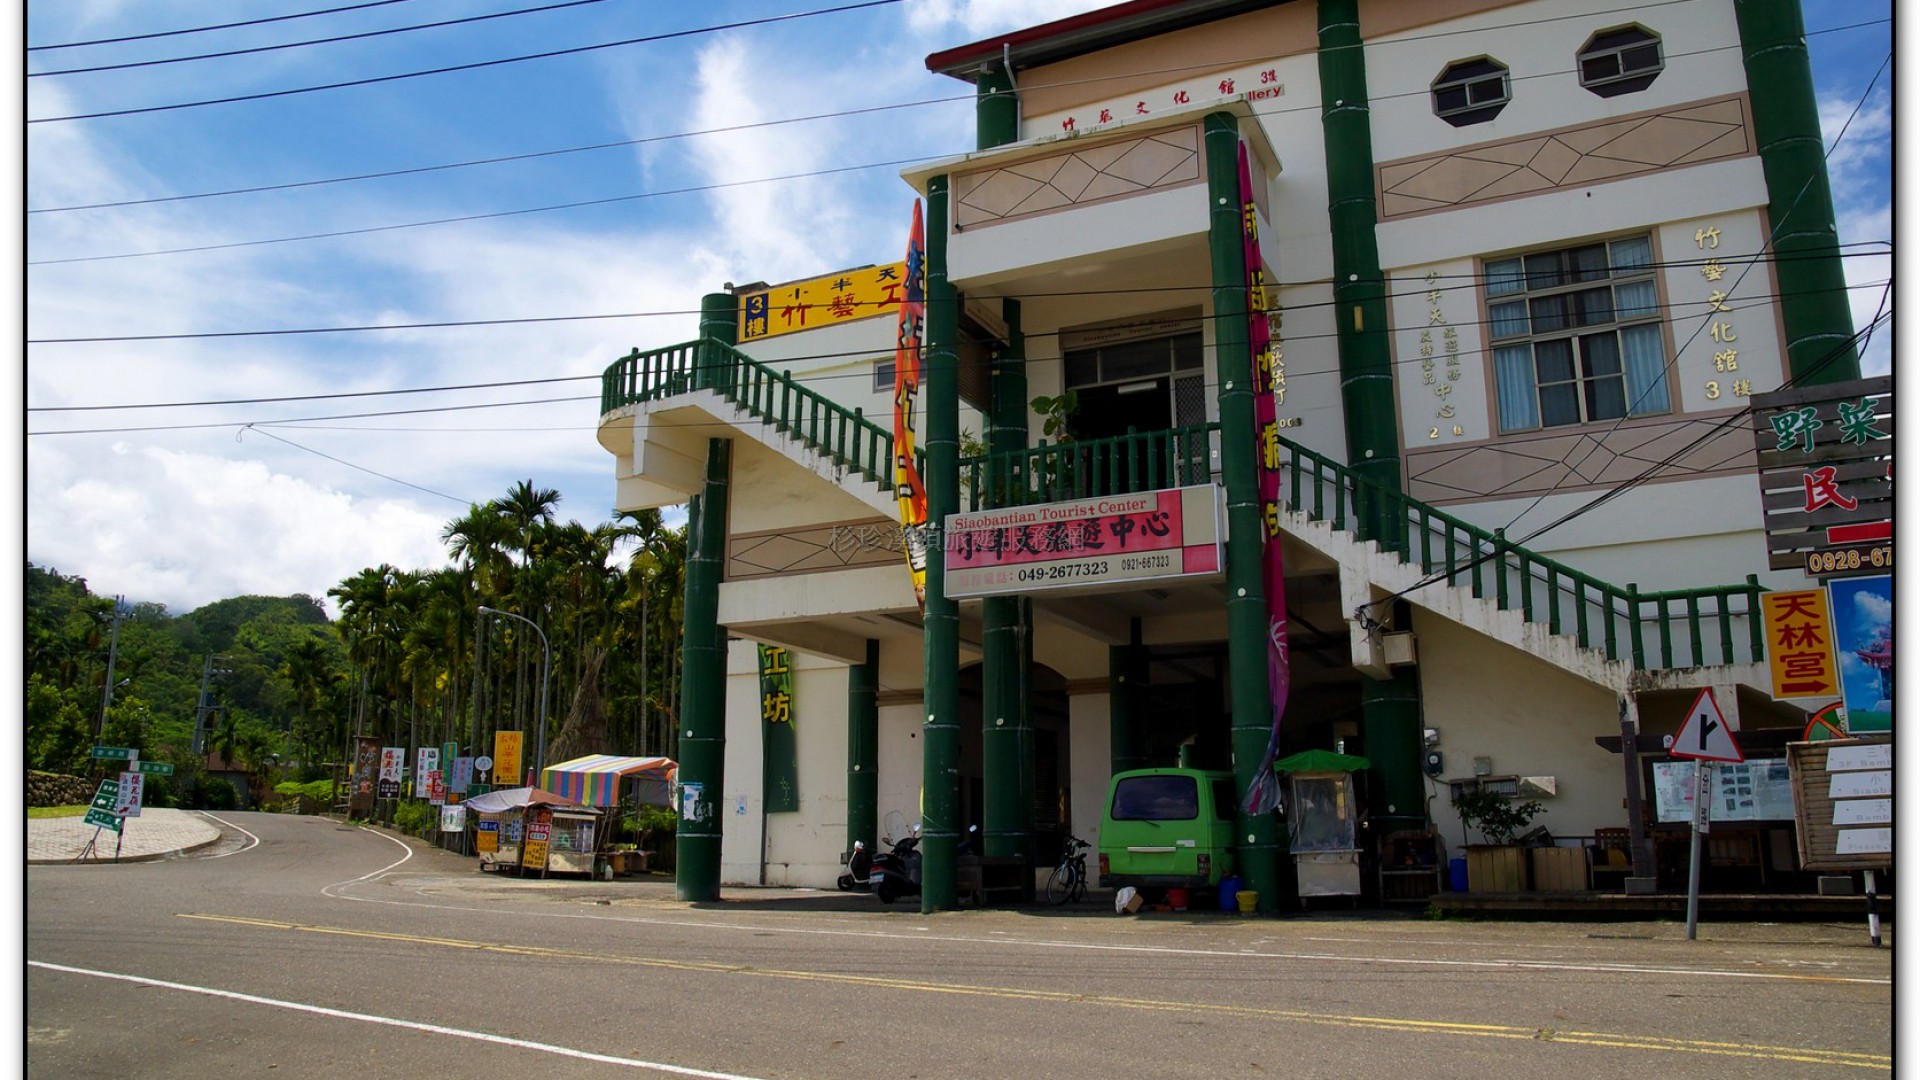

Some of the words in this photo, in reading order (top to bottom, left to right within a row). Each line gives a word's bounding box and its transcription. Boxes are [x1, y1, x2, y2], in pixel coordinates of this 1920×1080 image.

[787, 266, 901, 302] 小半天
[1695, 225, 1739, 373] 竹藝文化館
[746, 296, 768, 338] 3樓
[1769, 398, 1889, 454] 野菜
[954, 511, 1036, 530] Siaobantian
[1039, 505, 1095, 521] Tourist
[1098, 498, 1147, 514] Center
[1017, 561, 1109, 583] 049-2677323
[1121, 555, 1170, 572] 0921-667323
[1772, 592, 1828, 679] 天林宮
[763, 647, 789, 723] 工坊
